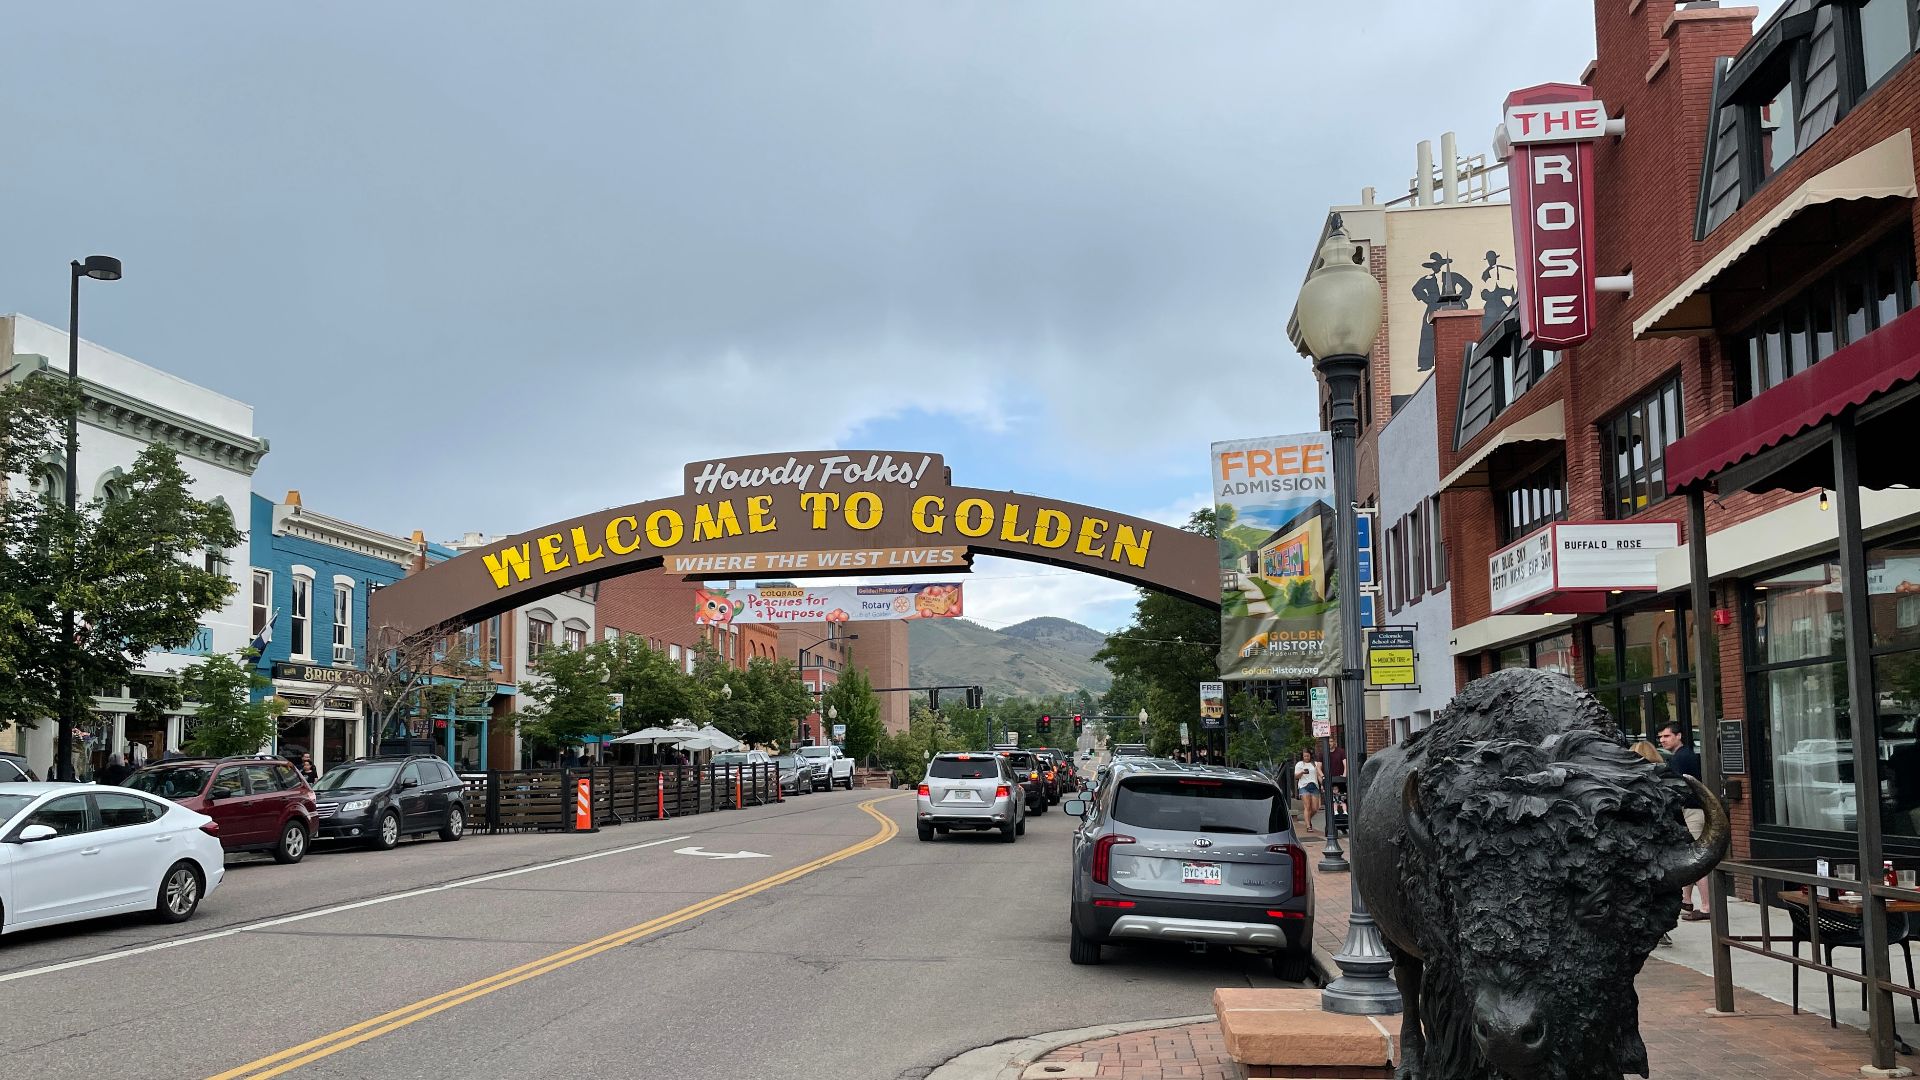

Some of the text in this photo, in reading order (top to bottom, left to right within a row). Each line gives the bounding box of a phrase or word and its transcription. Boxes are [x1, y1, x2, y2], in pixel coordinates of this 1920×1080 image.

[1513, 109, 1599, 135] THE
[1534, 154, 1579, 325] ROSE
[1220, 444, 1325, 481] FREE
[694, 455, 931, 494] Howdy Folks!
[1221, 476, 1326, 497] ADMISSION
[482, 491, 1153, 590] WELCOME TO GOLDEN
[1516, 545, 1526, 564] SKY
[1540, 534, 1548, 552] FRI
[1564, 539, 1642, 549] BUFFALO ROSE
[675, 549, 954, 571] WHERE THE WEST LIVES
[1492, 572, 1507, 591] PETTY
[747, 594, 829, 608] Peaches for
[862, 601, 891, 611] Rotary
[766, 606, 824, 620] Purpose
[1270, 631, 1325, 640] GOLDEN
[1269, 640, 1325, 651] HISTORY
[304, 666, 342, 682] BRICK
[1241, 667, 1319, 675] GoldenHistory.org
[1195, 839, 1210, 847] KIA
